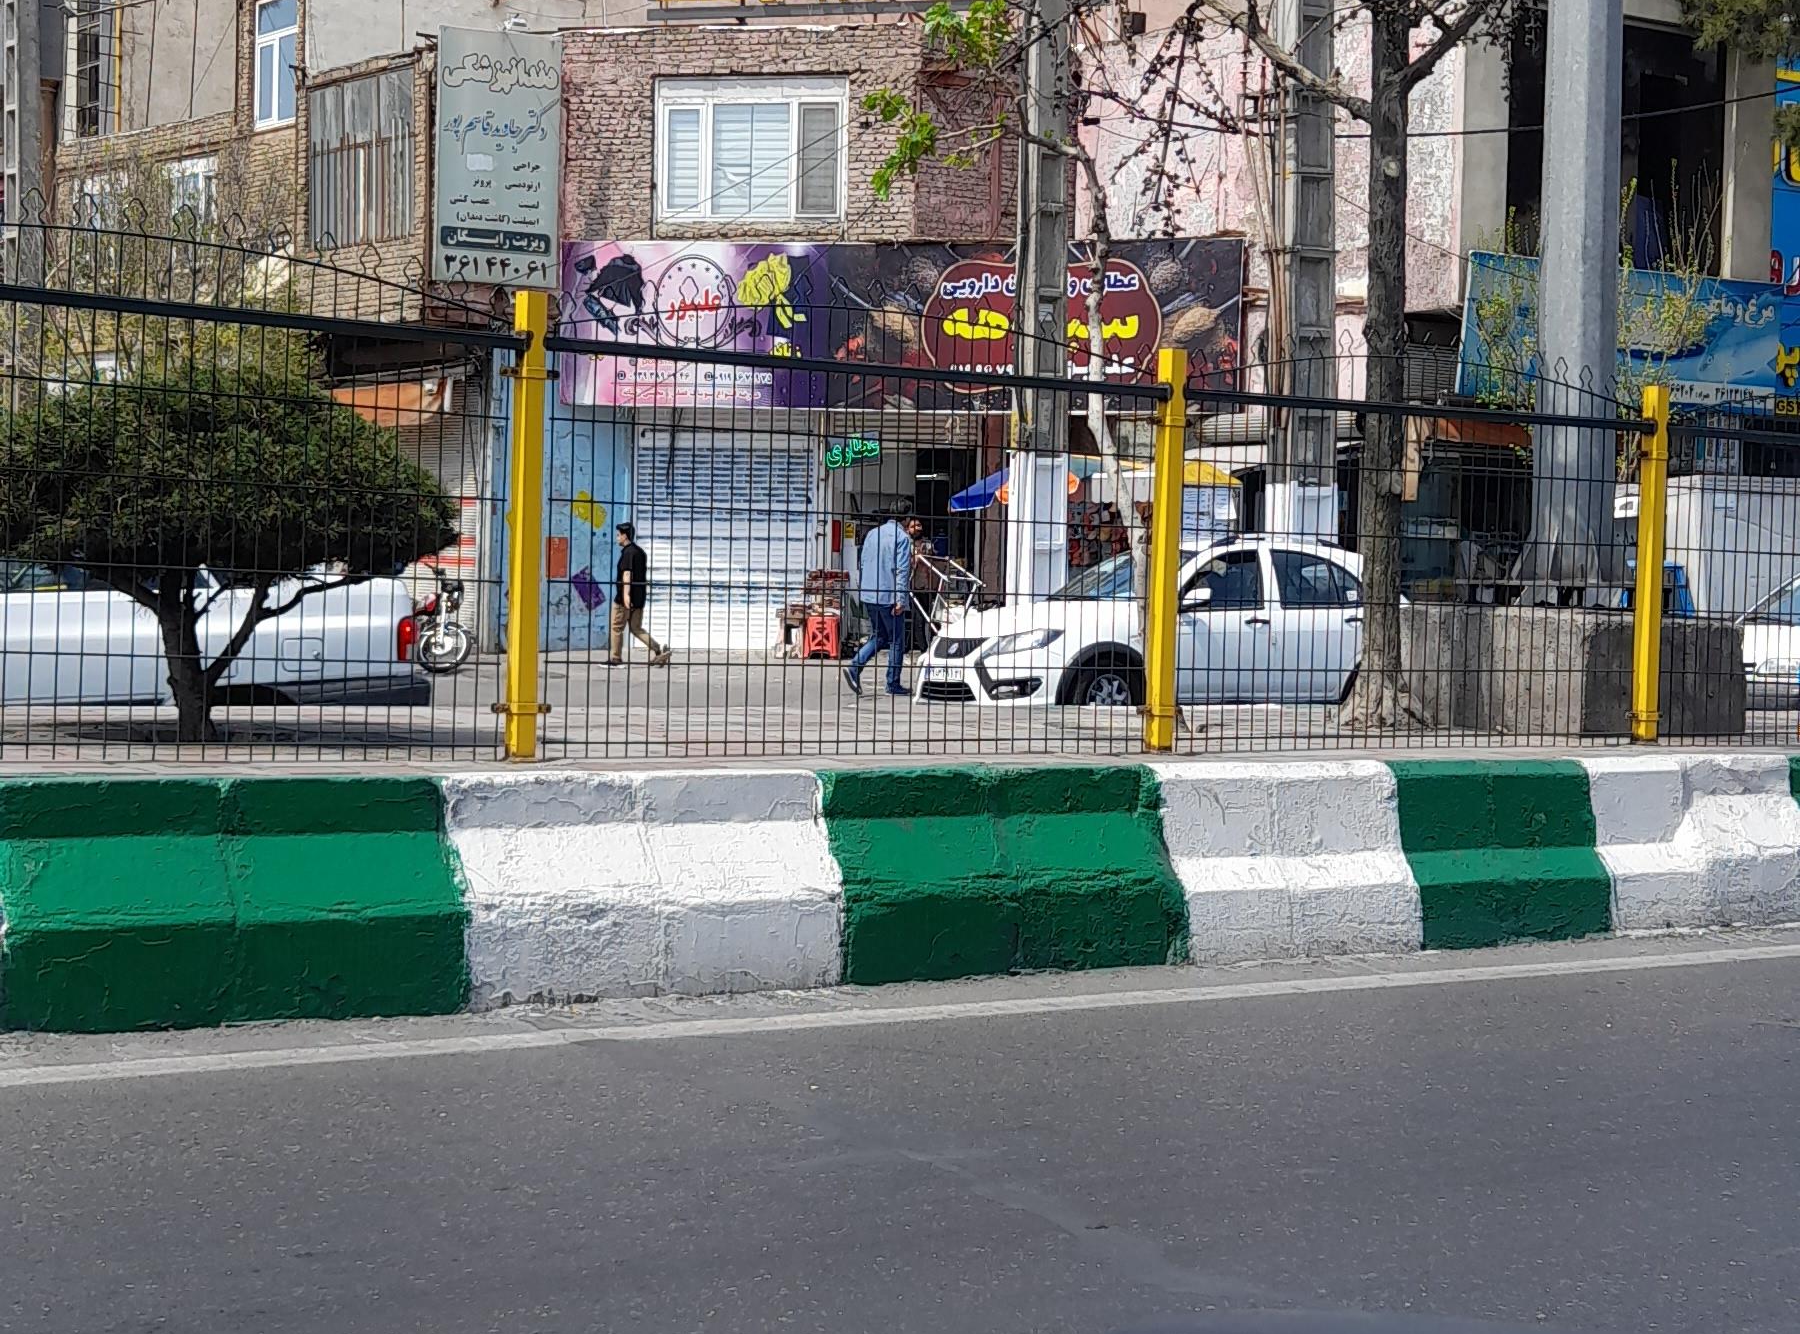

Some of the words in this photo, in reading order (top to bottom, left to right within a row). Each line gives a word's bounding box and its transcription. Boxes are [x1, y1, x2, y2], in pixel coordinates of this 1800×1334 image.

[442, 52, 560, 96] دندانپزشکی
[512, 161, 541, 173] جراحی
[447, 228, 510, 249] رایگان
[511, 234, 546, 253] ویزیت
[444, 253, 548, 282] ۳۶۱۴۴۰۶۱
[942, 273, 1000, 300] دارویی
